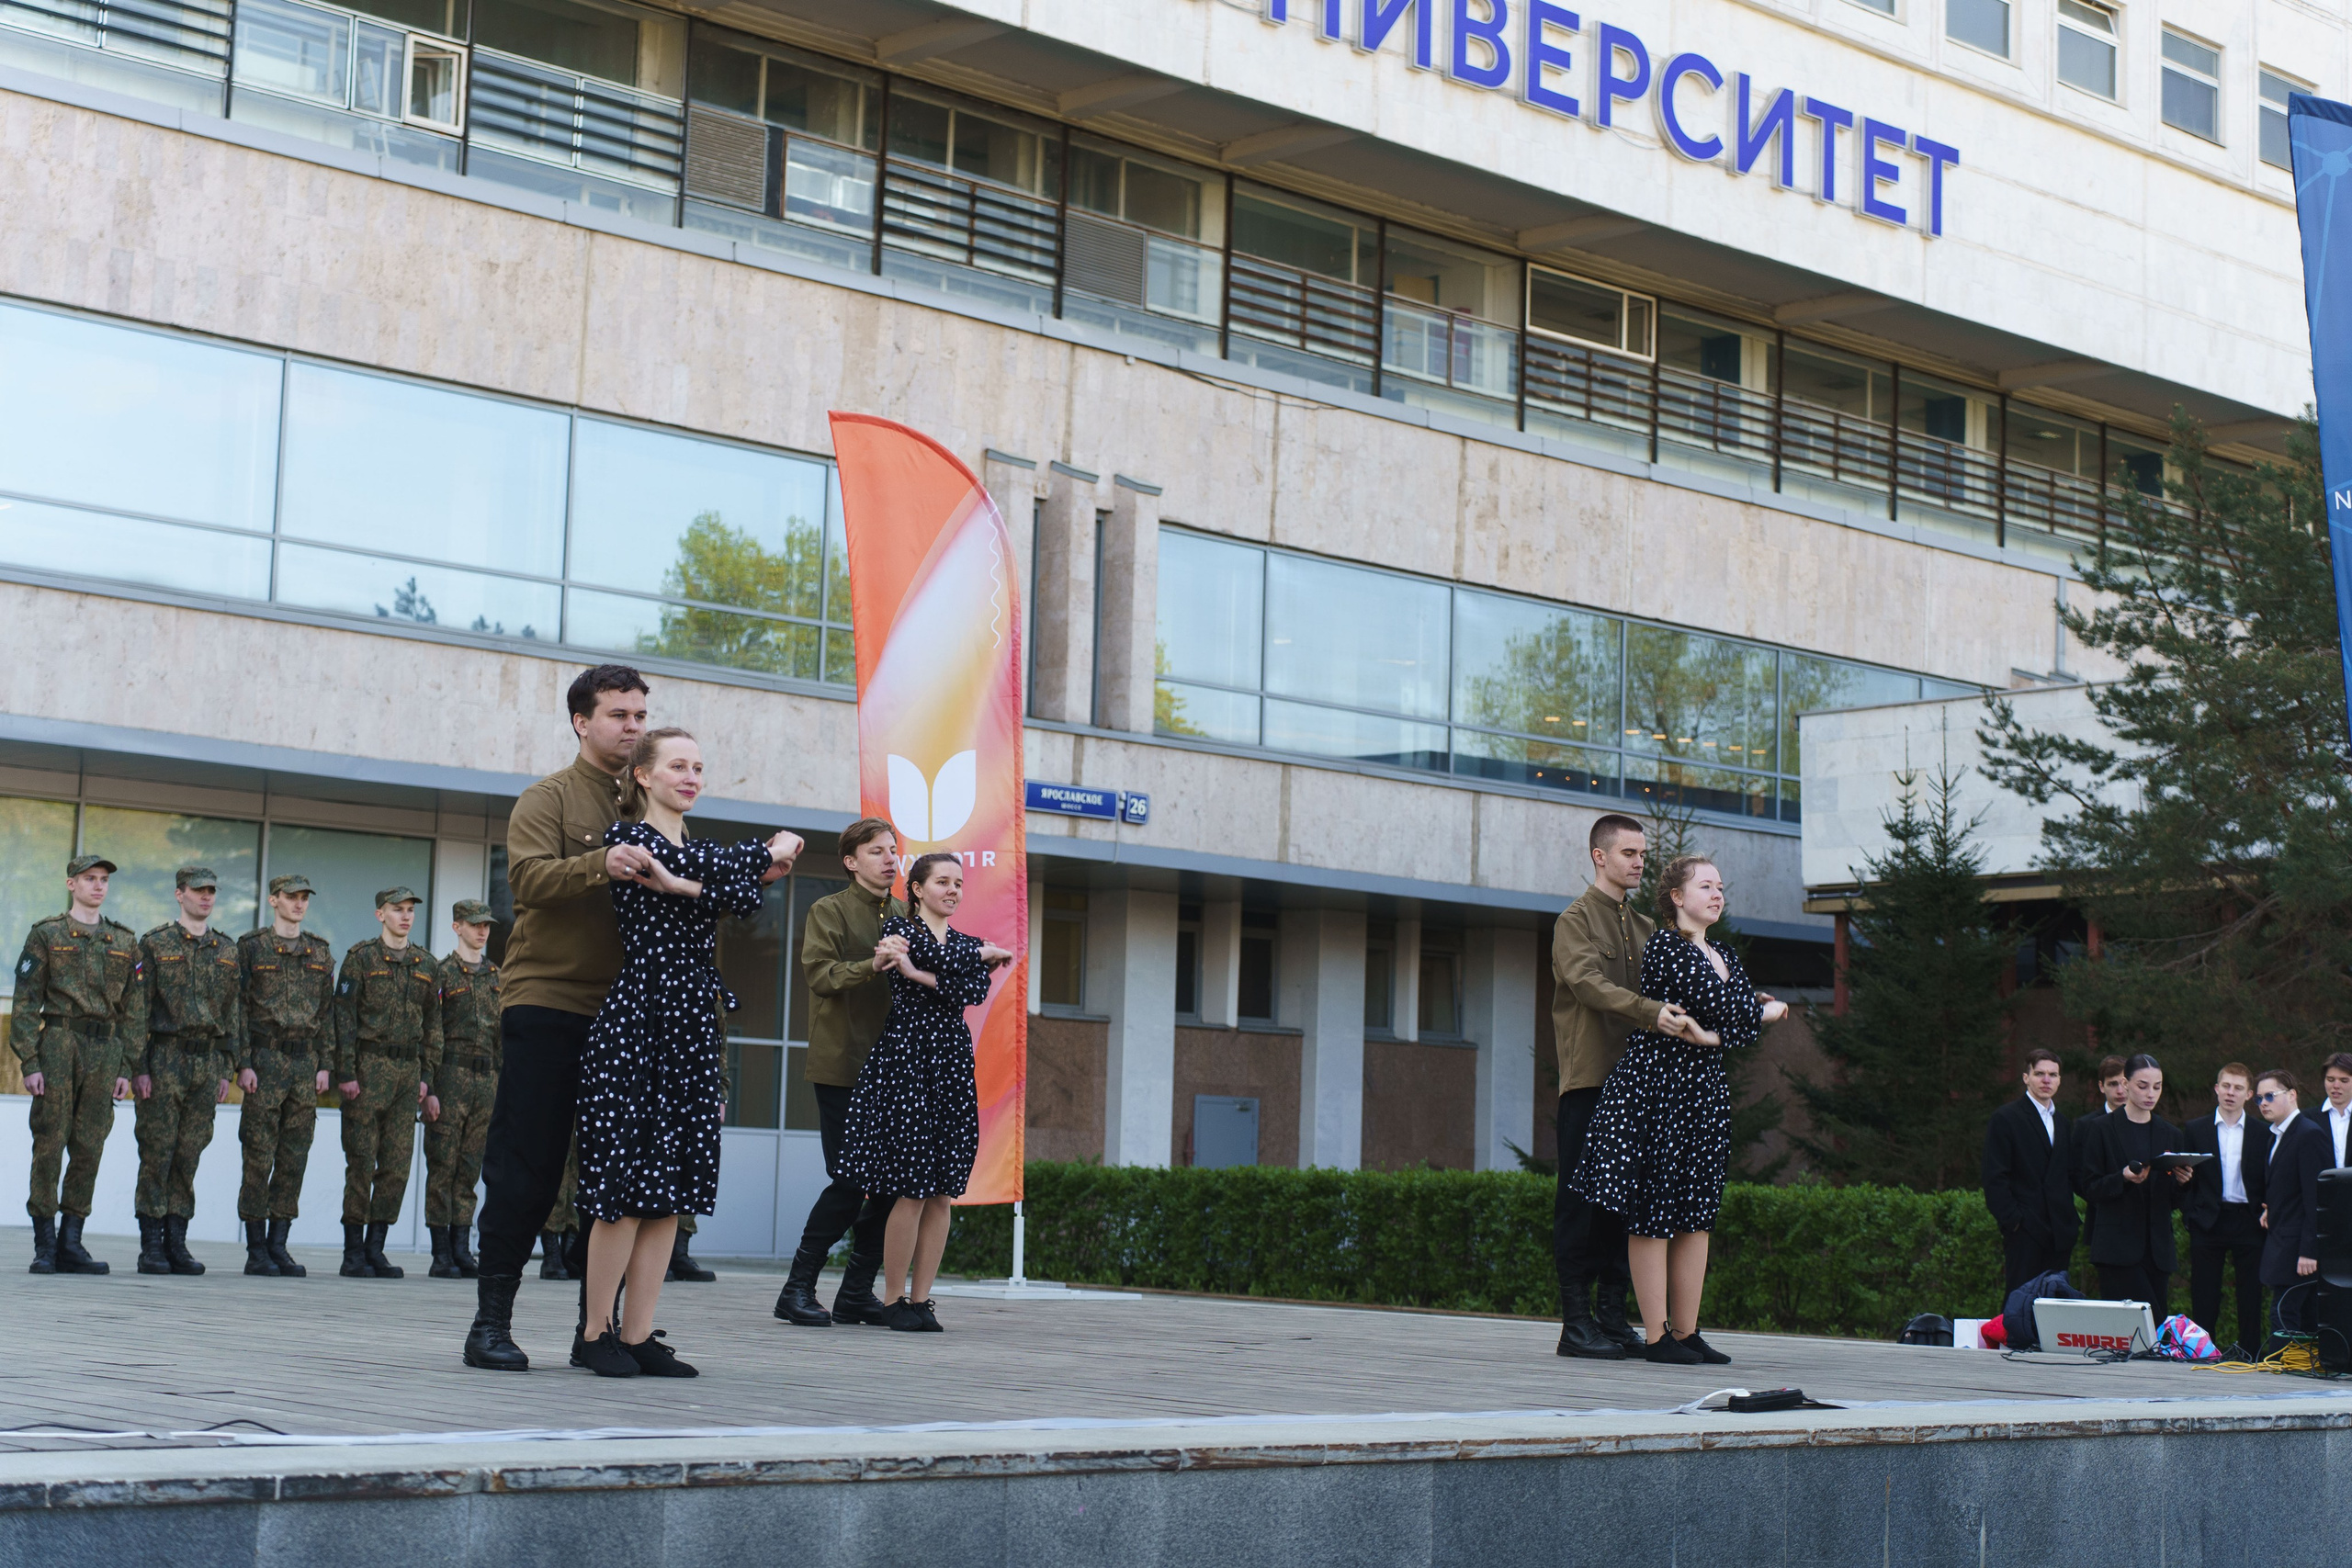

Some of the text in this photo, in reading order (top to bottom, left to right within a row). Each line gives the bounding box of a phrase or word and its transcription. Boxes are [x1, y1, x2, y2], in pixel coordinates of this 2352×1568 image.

[1041, 787, 1103, 806] ЯРОСЛАВСКОЕ
[1129, 797, 1147, 816] 26
[2057, 1333, 2131, 1350] SHURE
